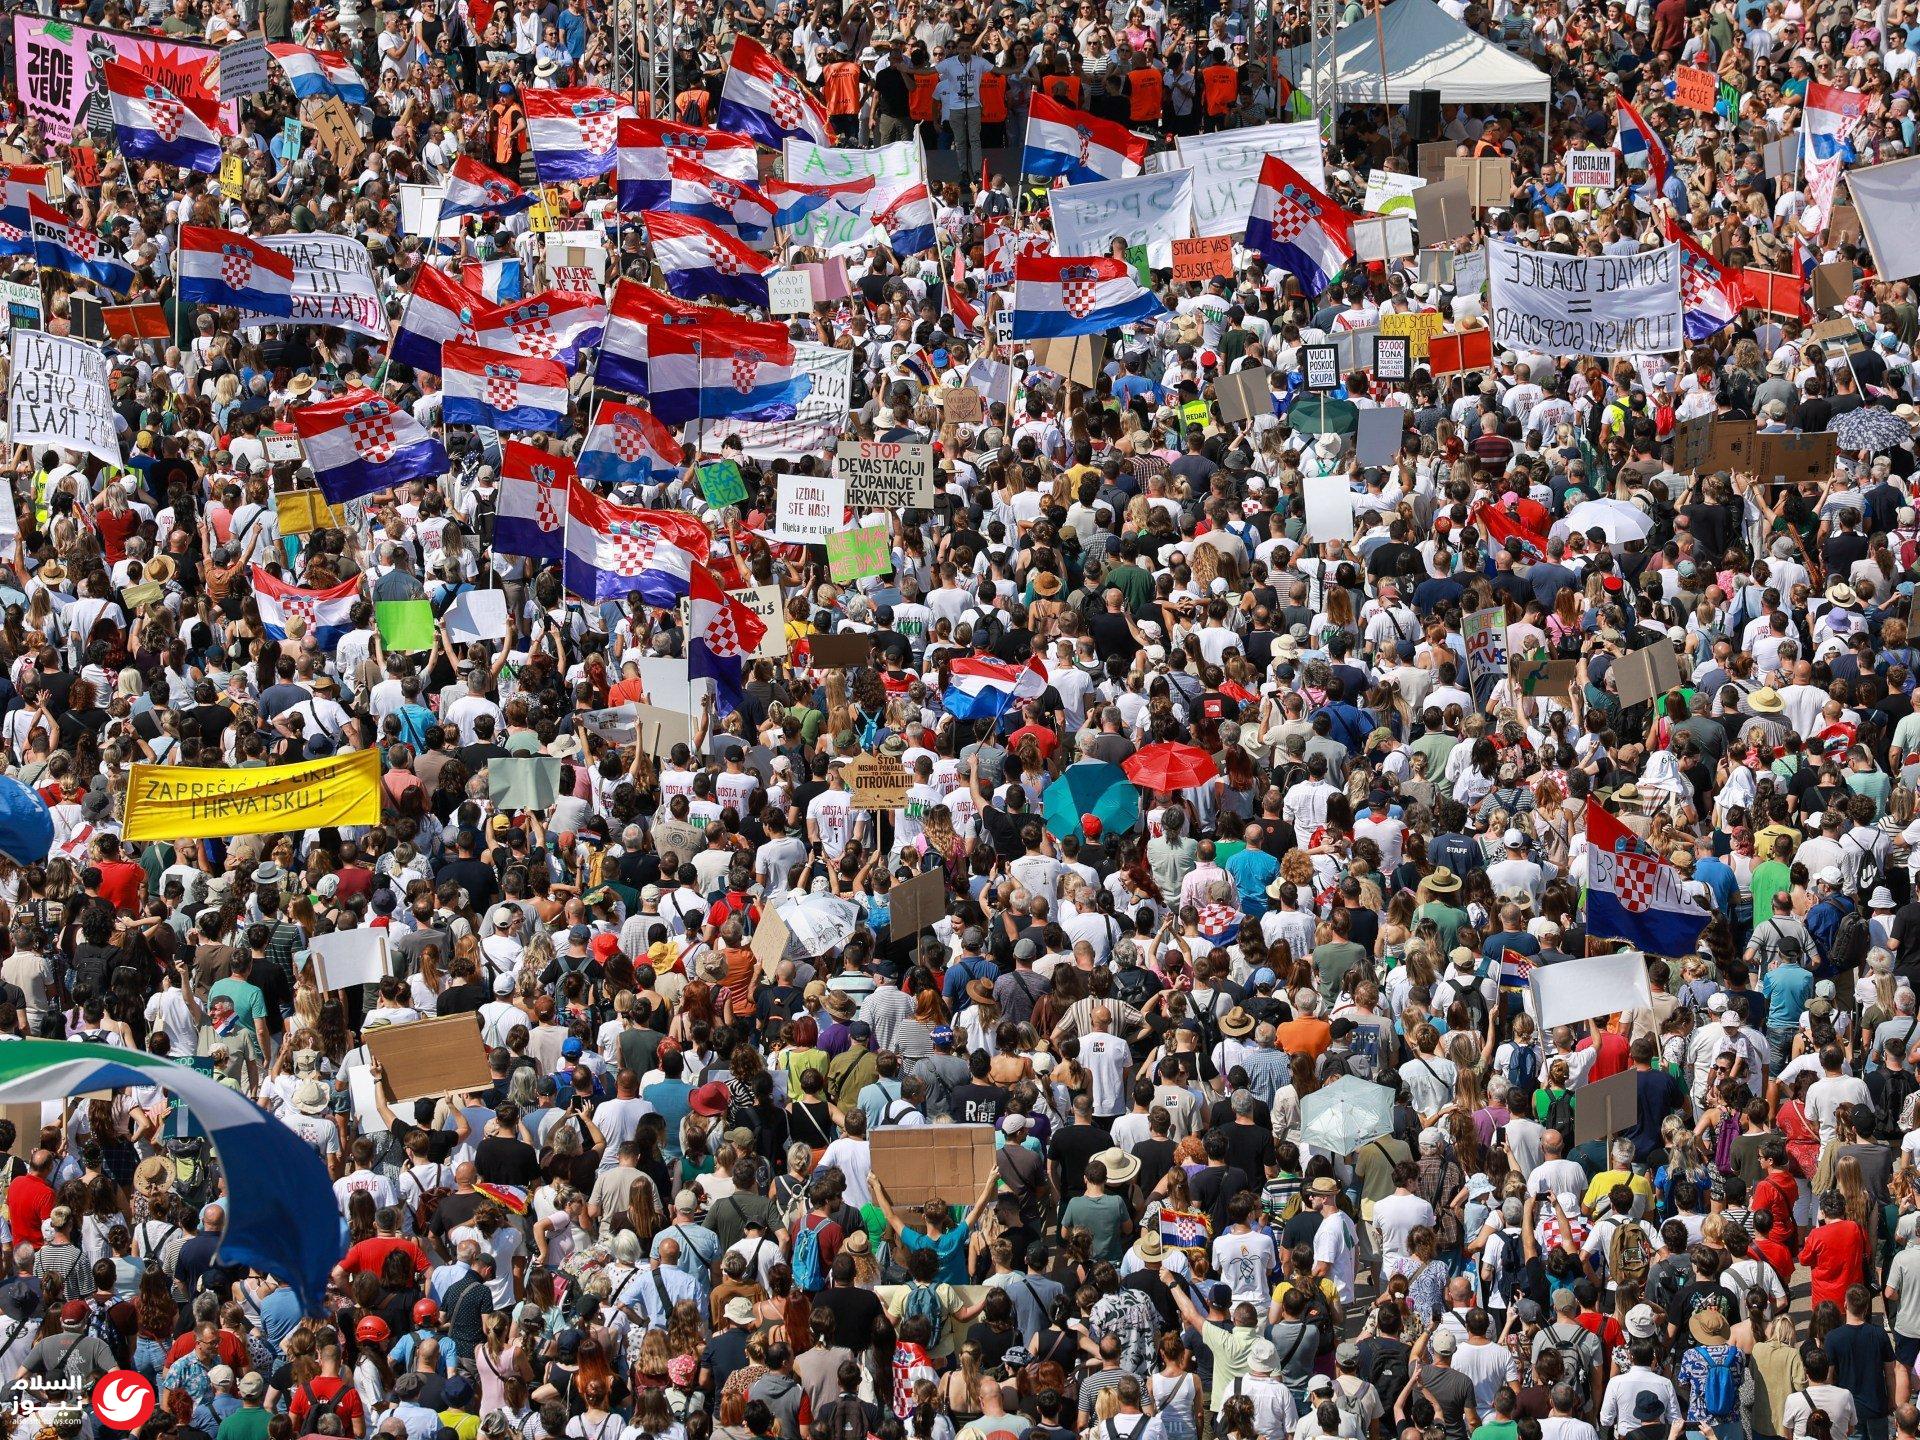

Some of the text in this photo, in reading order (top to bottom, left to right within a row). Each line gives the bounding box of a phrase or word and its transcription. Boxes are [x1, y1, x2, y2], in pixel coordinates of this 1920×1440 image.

[1573, 156, 1610, 171] POSTAJEM
[1210, 240, 1228, 252] VAS
[552, 267, 596, 281] VRIJEME
[777, 274, 804, 286] KAD?
[987, 271, 1014, 284] HRVA
[571, 280, 592, 292] ZA
[794, 287, 804, 296] NE
[780, 299, 806, 308] SAD?
[999, 312, 1013, 324] GO
[999, 329, 1013, 342] PO
[1379, 342, 1403, 350] 37.000
[1309, 351, 1326, 360] VUCI
[1310, 361, 1335, 371] POSKOCI
[1310, 373, 1335, 384] SKUPA!
[1186, 412, 1206, 421] REDAR
[860, 443, 901, 459] STOP
[839, 457, 925, 476] DEVASTACIJI
[850, 473, 923, 491] ŽUPANIJE I
[795, 488, 824, 501] IZDALI
[846, 489, 916, 507] HRVATSKE
[788, 502, 830, 517] STE NAS!
[877, 755, 894, 765] ŠTO
[856, 776, 913, 789] OTROVALI!!!
[718, 787, 737, 798] DOSTA
[203, 793, 309, 818] HRVATSKU
[822, 805, 842, 815] DOSTA
[1446, 847, 1468, 855] STAFF
